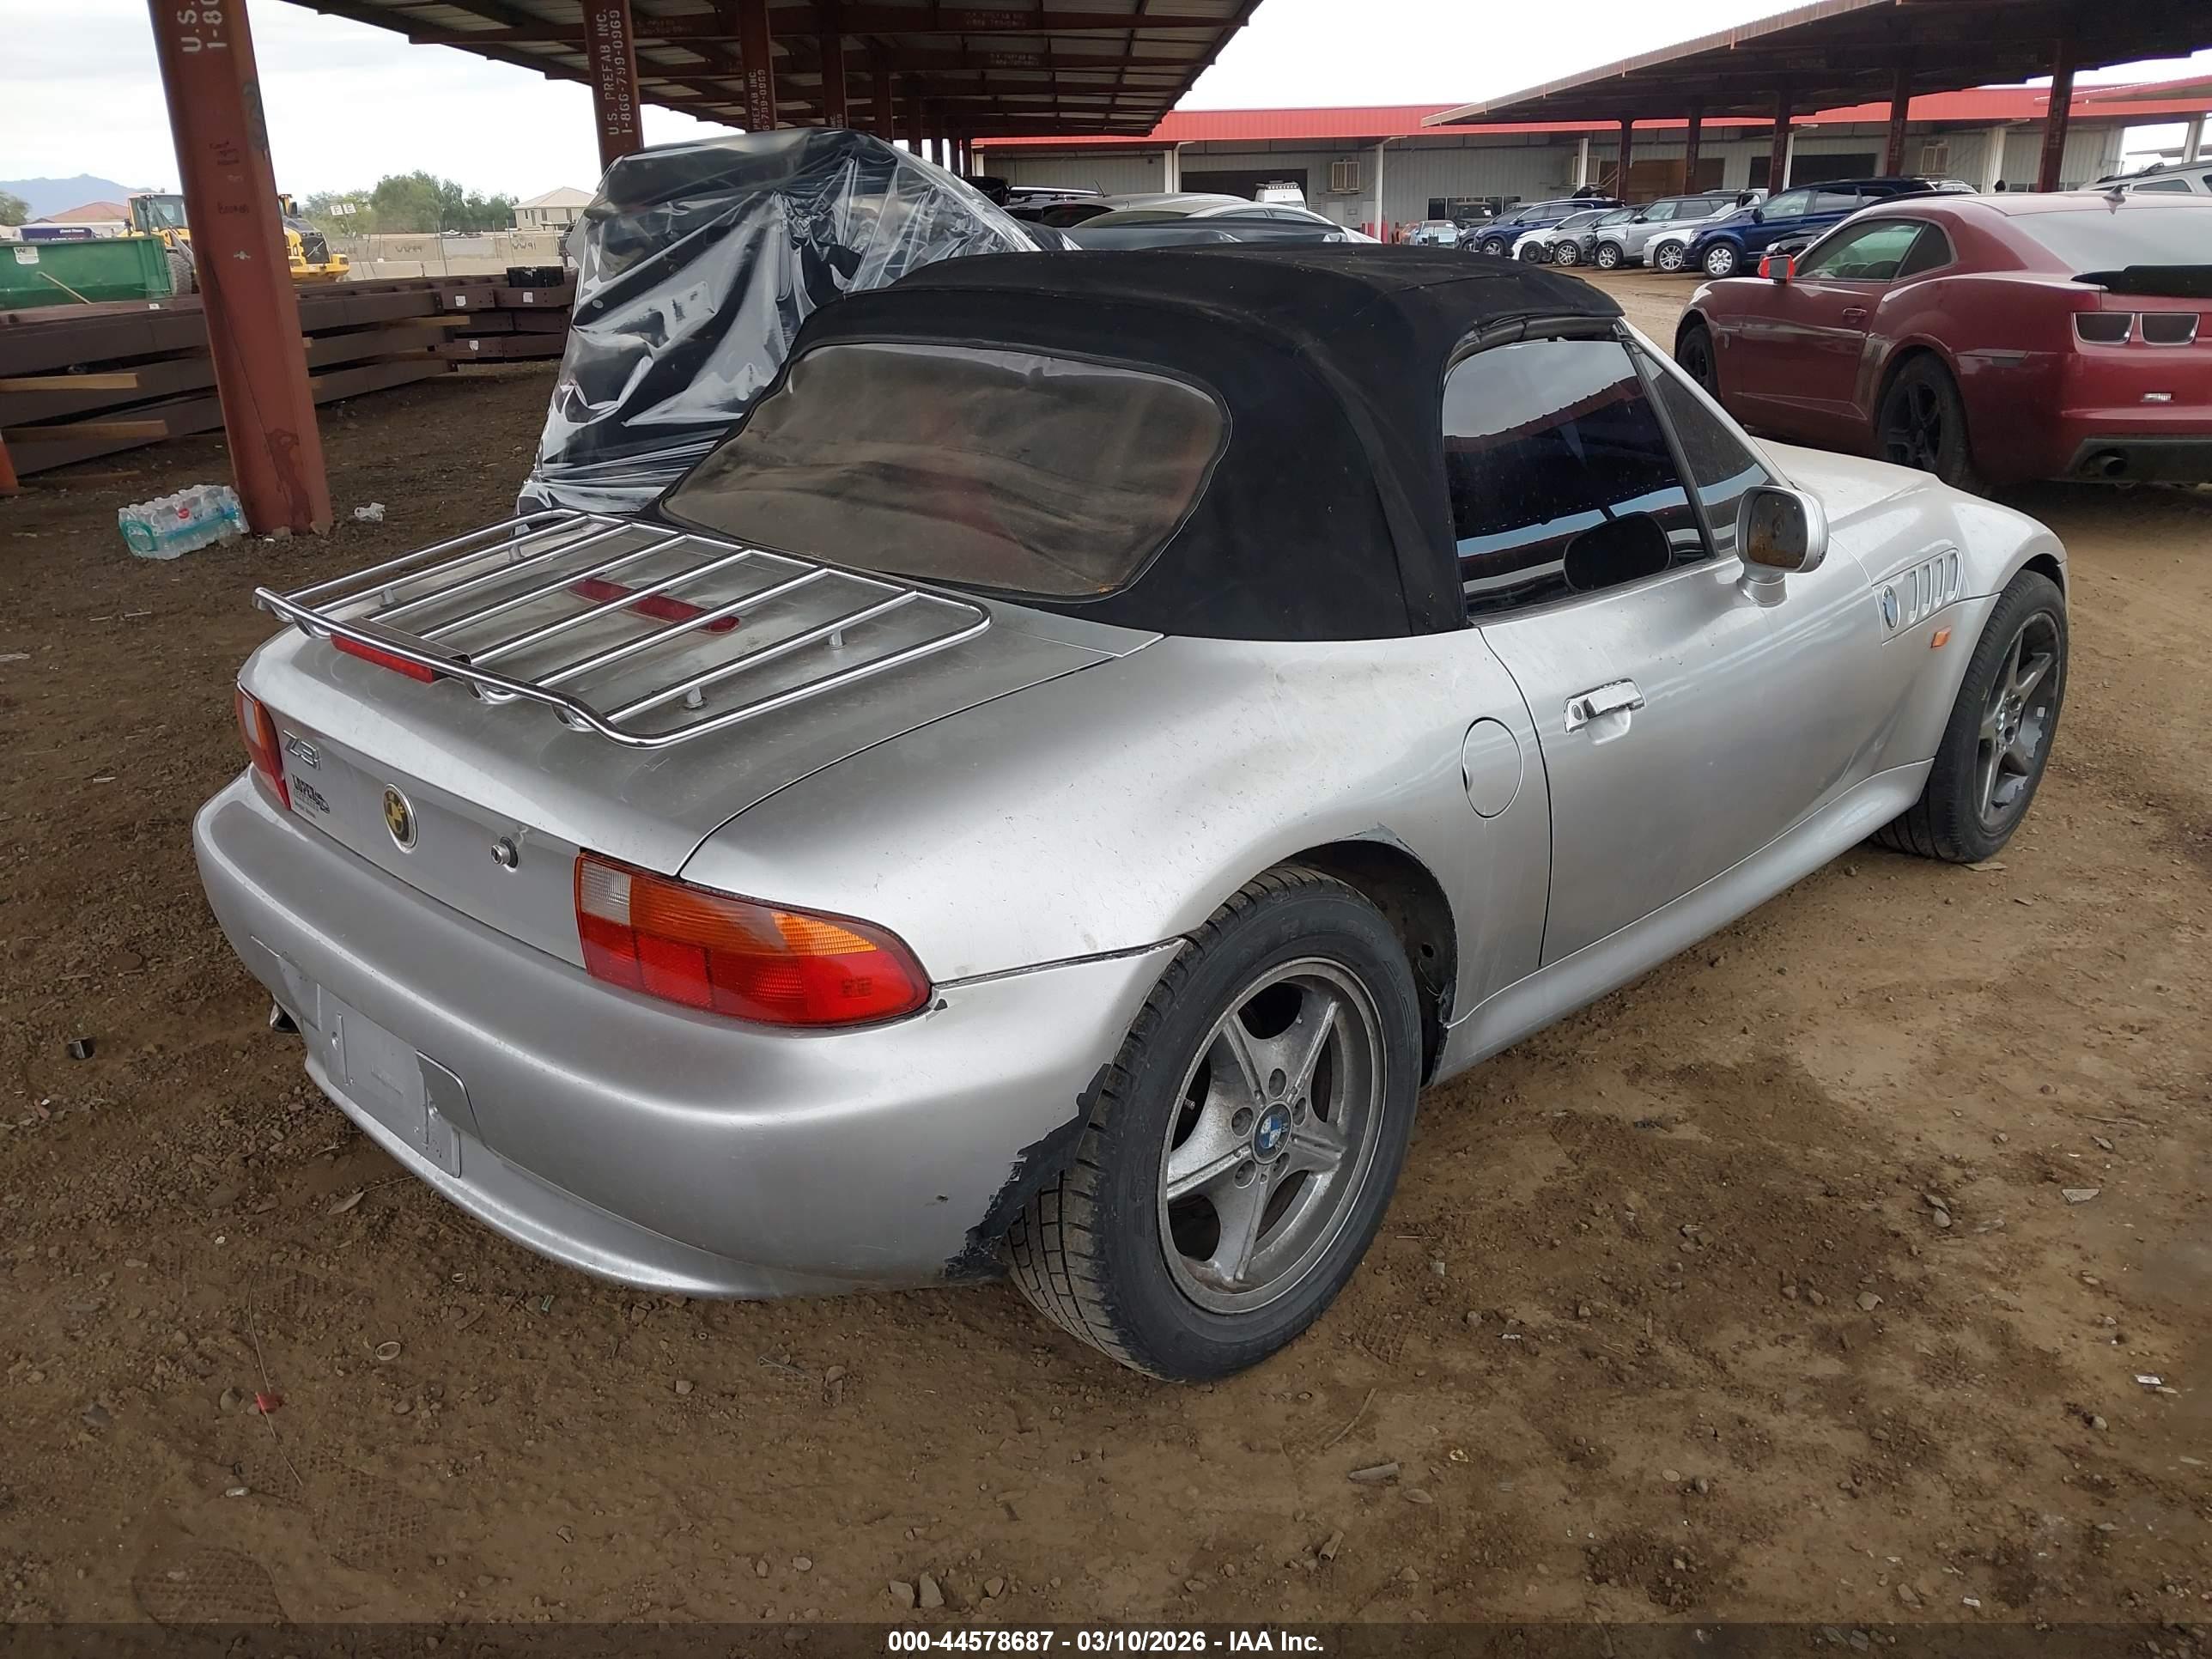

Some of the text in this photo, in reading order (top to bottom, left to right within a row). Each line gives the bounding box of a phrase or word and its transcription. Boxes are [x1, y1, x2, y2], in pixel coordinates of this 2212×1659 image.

[596, 9, 620, 136] U.S. PREFAB INC.
[609, 9, 633, 134] 1-866-799-0969
